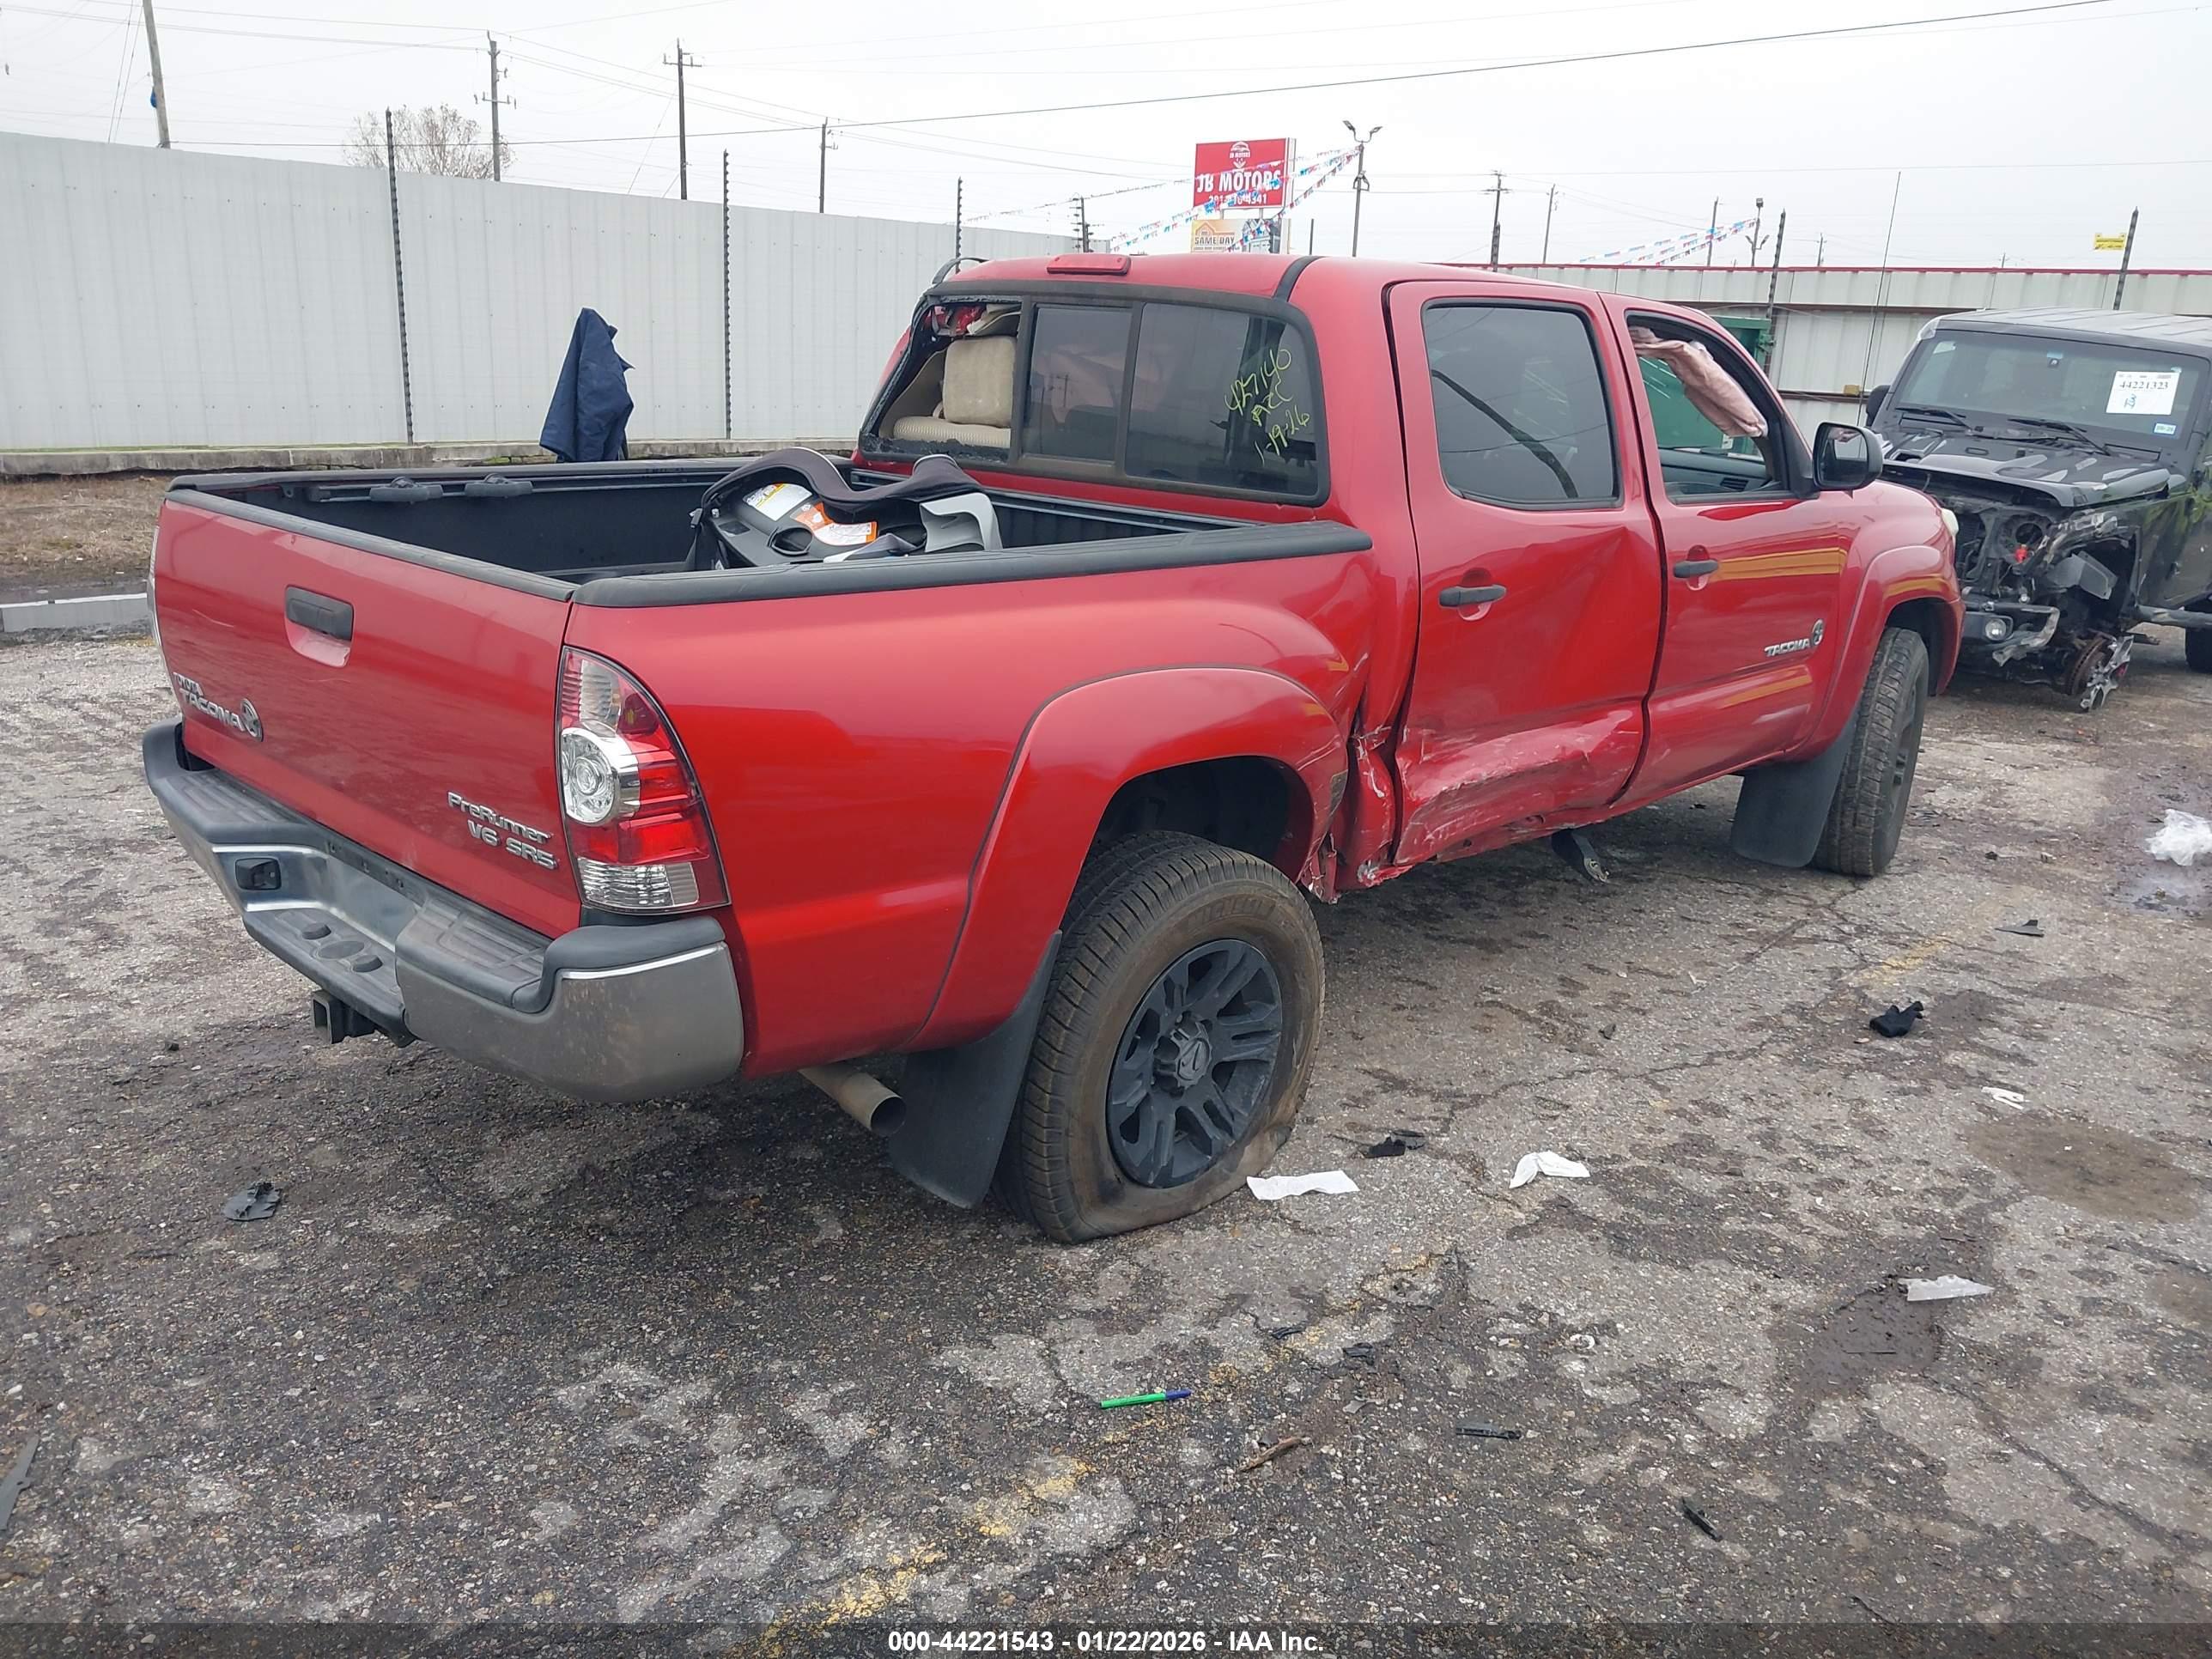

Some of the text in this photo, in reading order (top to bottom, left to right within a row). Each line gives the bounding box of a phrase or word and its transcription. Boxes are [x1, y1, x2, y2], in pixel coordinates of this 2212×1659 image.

[1196, 170, 1281, 192] JB MOTORS
[1194, 235, 1235, 245] SAME DAY
[1764, 638, 1810, 656] TACOMA
[179, 687, 246, 732] TACOMA
[447, 791, 552, 844] PreRunner
[467, 819, 559, 870] V6 SR5
